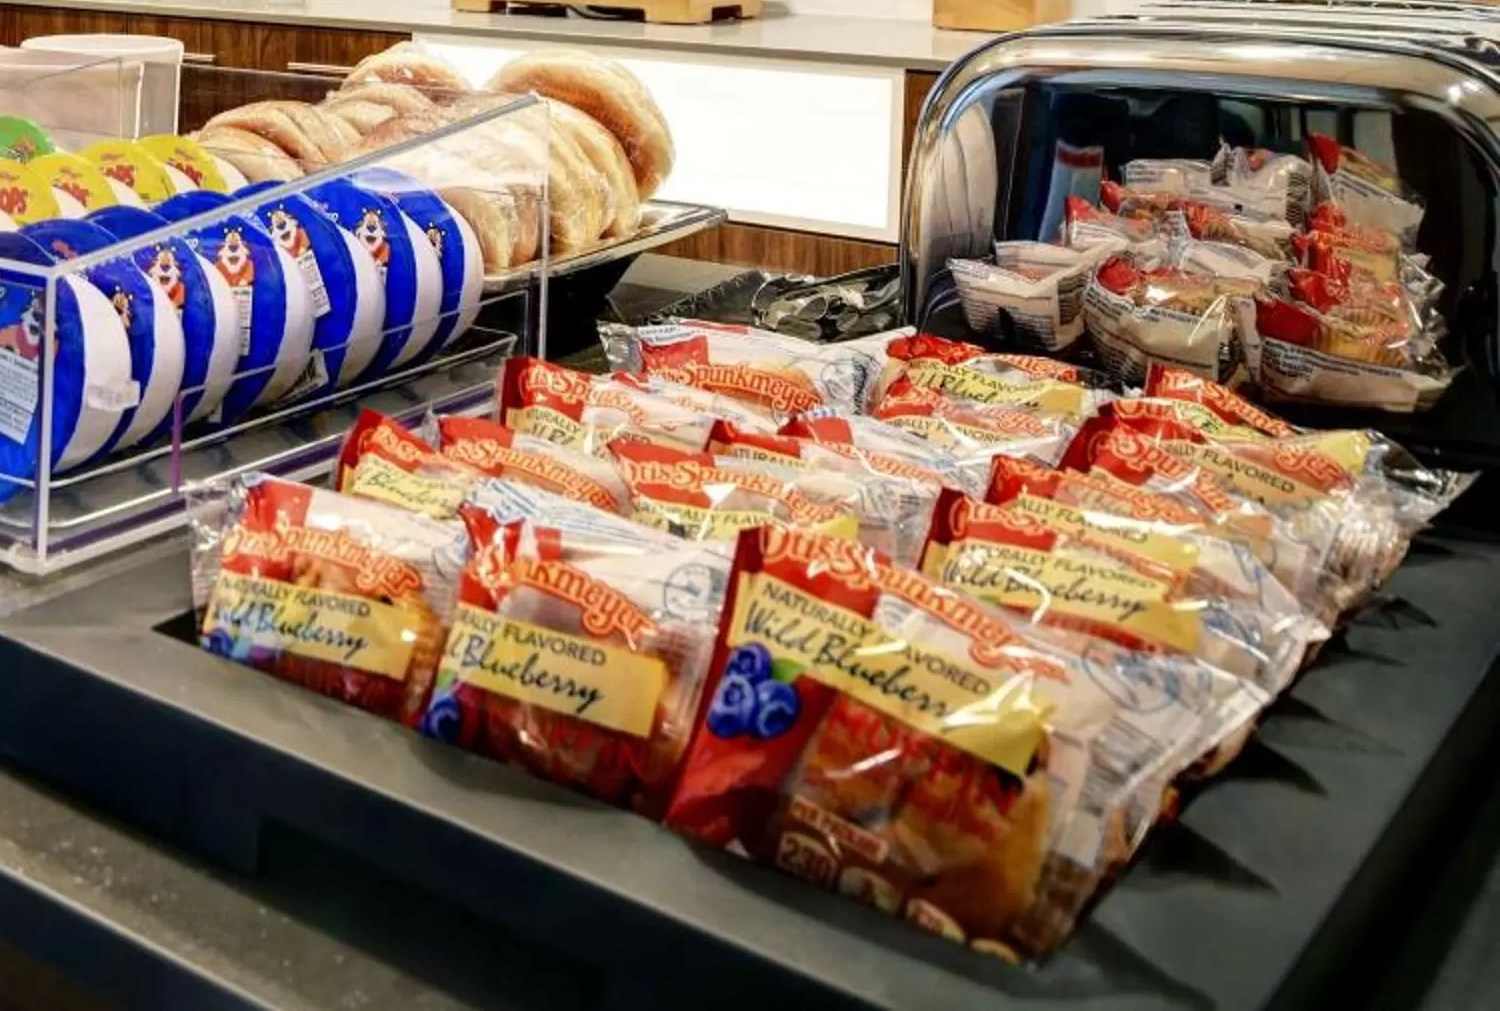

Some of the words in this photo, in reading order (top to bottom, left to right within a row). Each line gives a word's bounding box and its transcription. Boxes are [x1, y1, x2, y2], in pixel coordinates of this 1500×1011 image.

[680, 358, 823, 417] Spunkmeyer
[1203, 448, 1296, 493] FLAVORED
[744, 599, 821, 655] Wild
[762, 580, 873, 637] NATURALLY
[502, 619, 607, 667] FLAVORED
[460, 632, 606, 714] Blueberry
